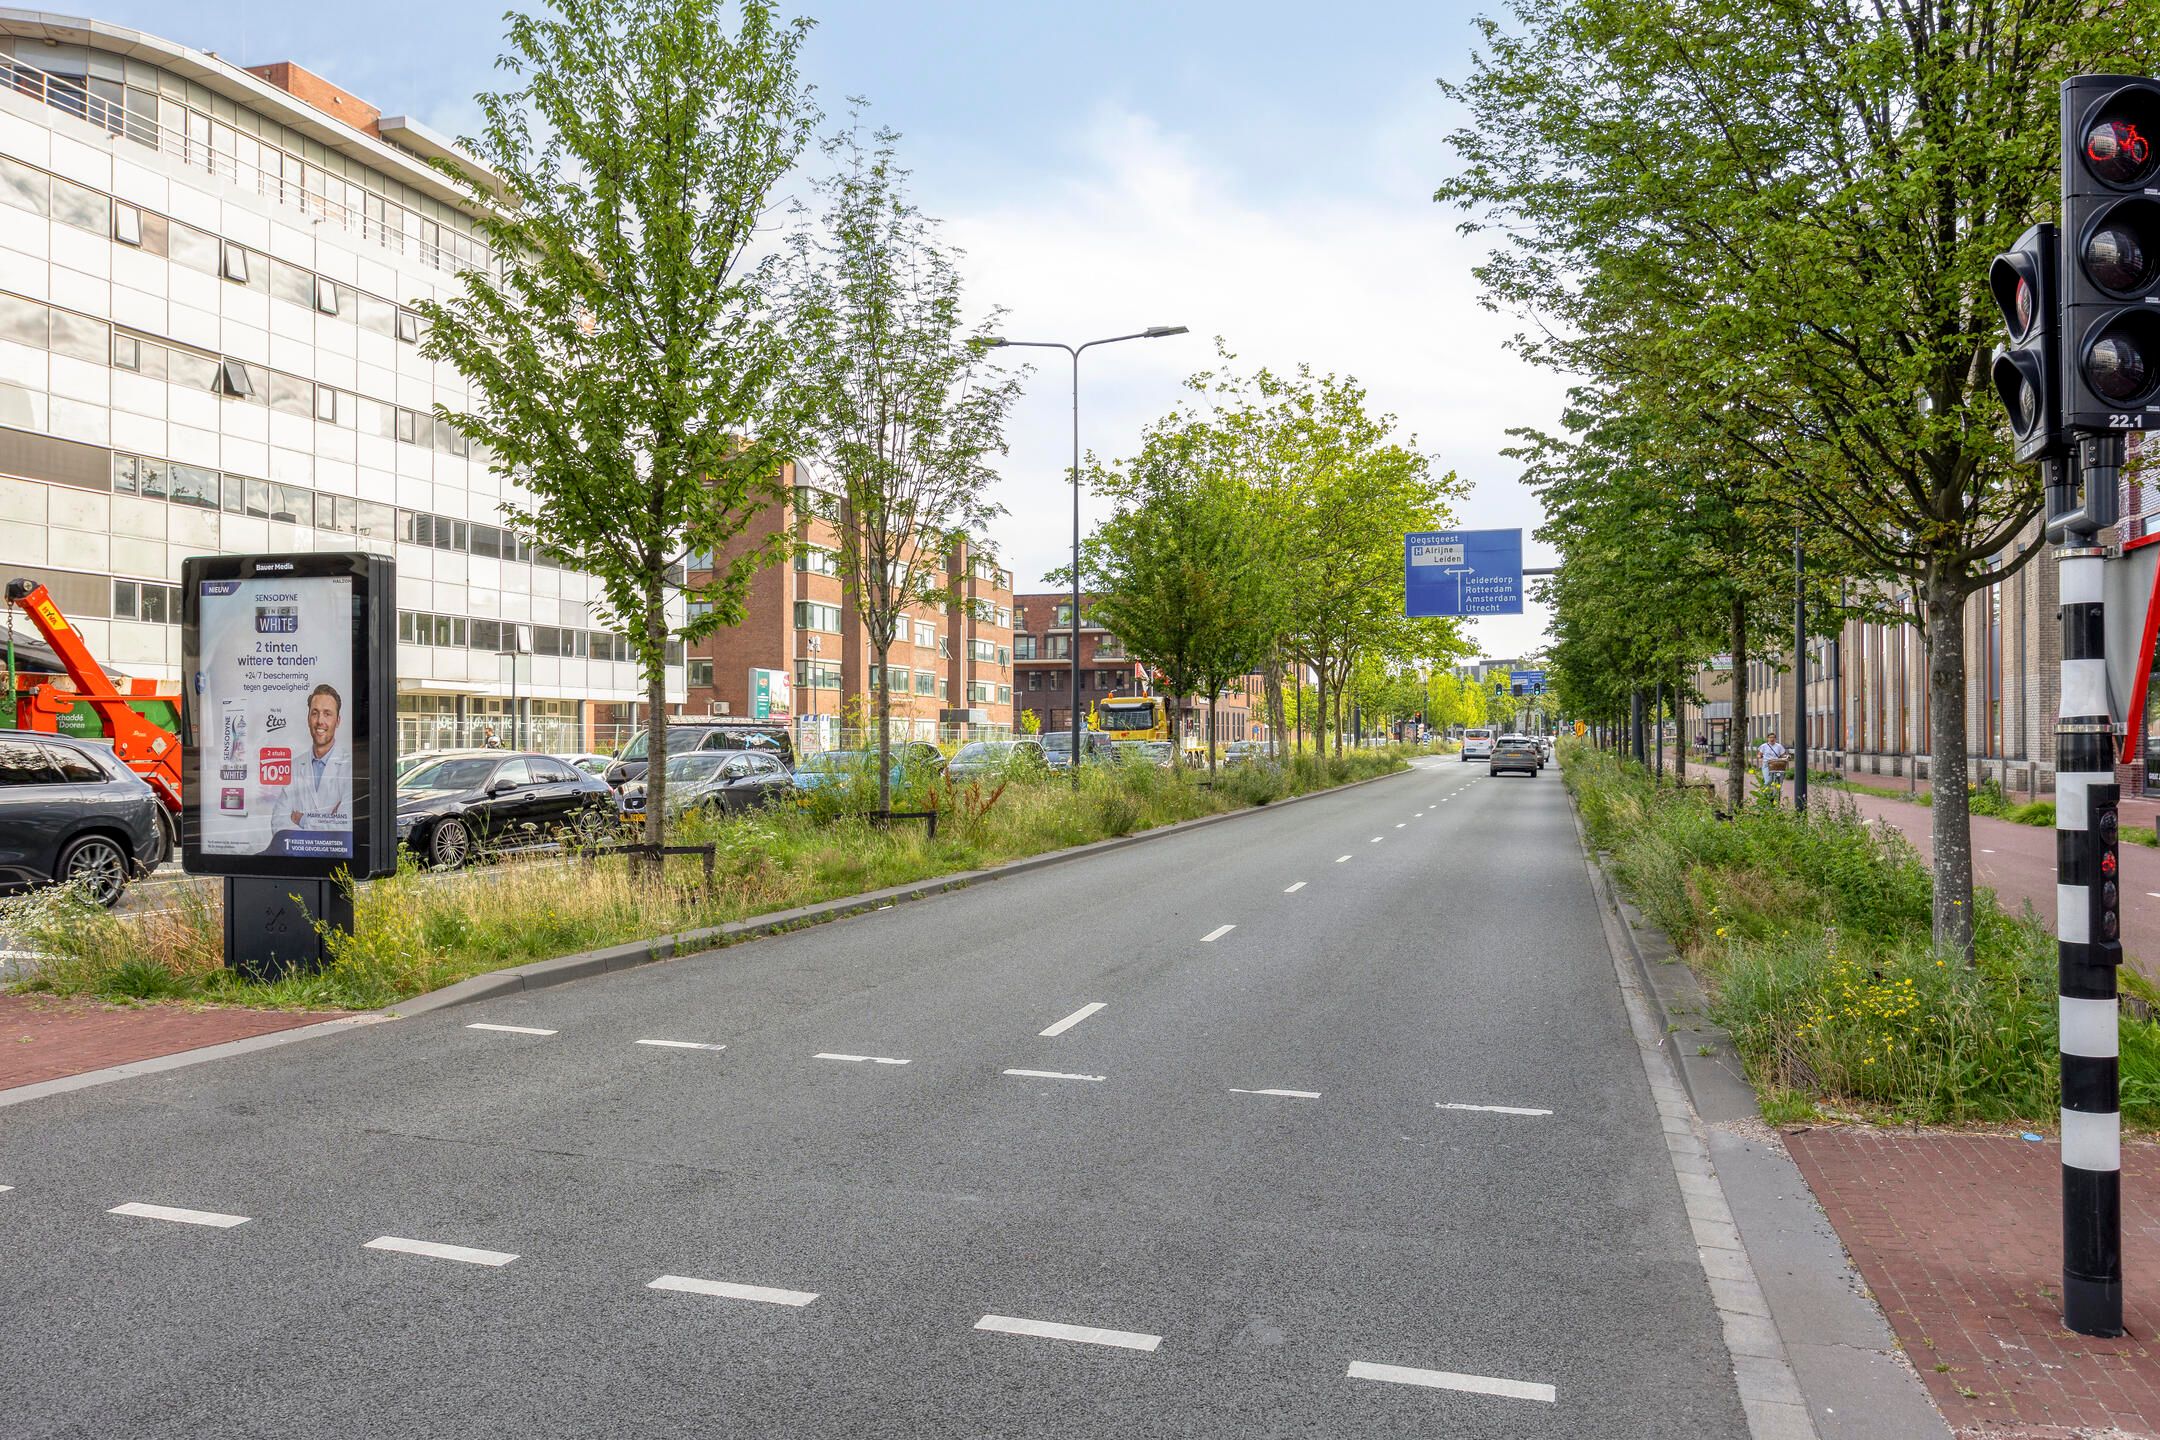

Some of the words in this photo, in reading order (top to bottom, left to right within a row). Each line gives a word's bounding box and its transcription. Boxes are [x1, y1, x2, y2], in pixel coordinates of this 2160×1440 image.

[2108, 414, 2143, 428] 22.1
[1410, 536, 1459, 545] Oegstgeest
[1425, 547, 1454, 555] Alrijne
[1466, 576, 1513, 585] Leiderdorp
[1466, 595, 1517, 603] Amsterdam
[1466, 604, 1500, 612] Utrecht
[41, 606, 57, 626] HYVA
[259, 618, 293, 631] WHITE
[256, 641, 262, 652] 2
[265, 641, 298, 652] tinten
[237, 654, 274, 666] wittere
[263, 672, 309, 681] bescherming
[243, 684, 261, 692] tegen
[59, 721, 86, 729] Dooren
[266, 714, 287, 728] Etos
[223, 771, 244, 780] WHITE
